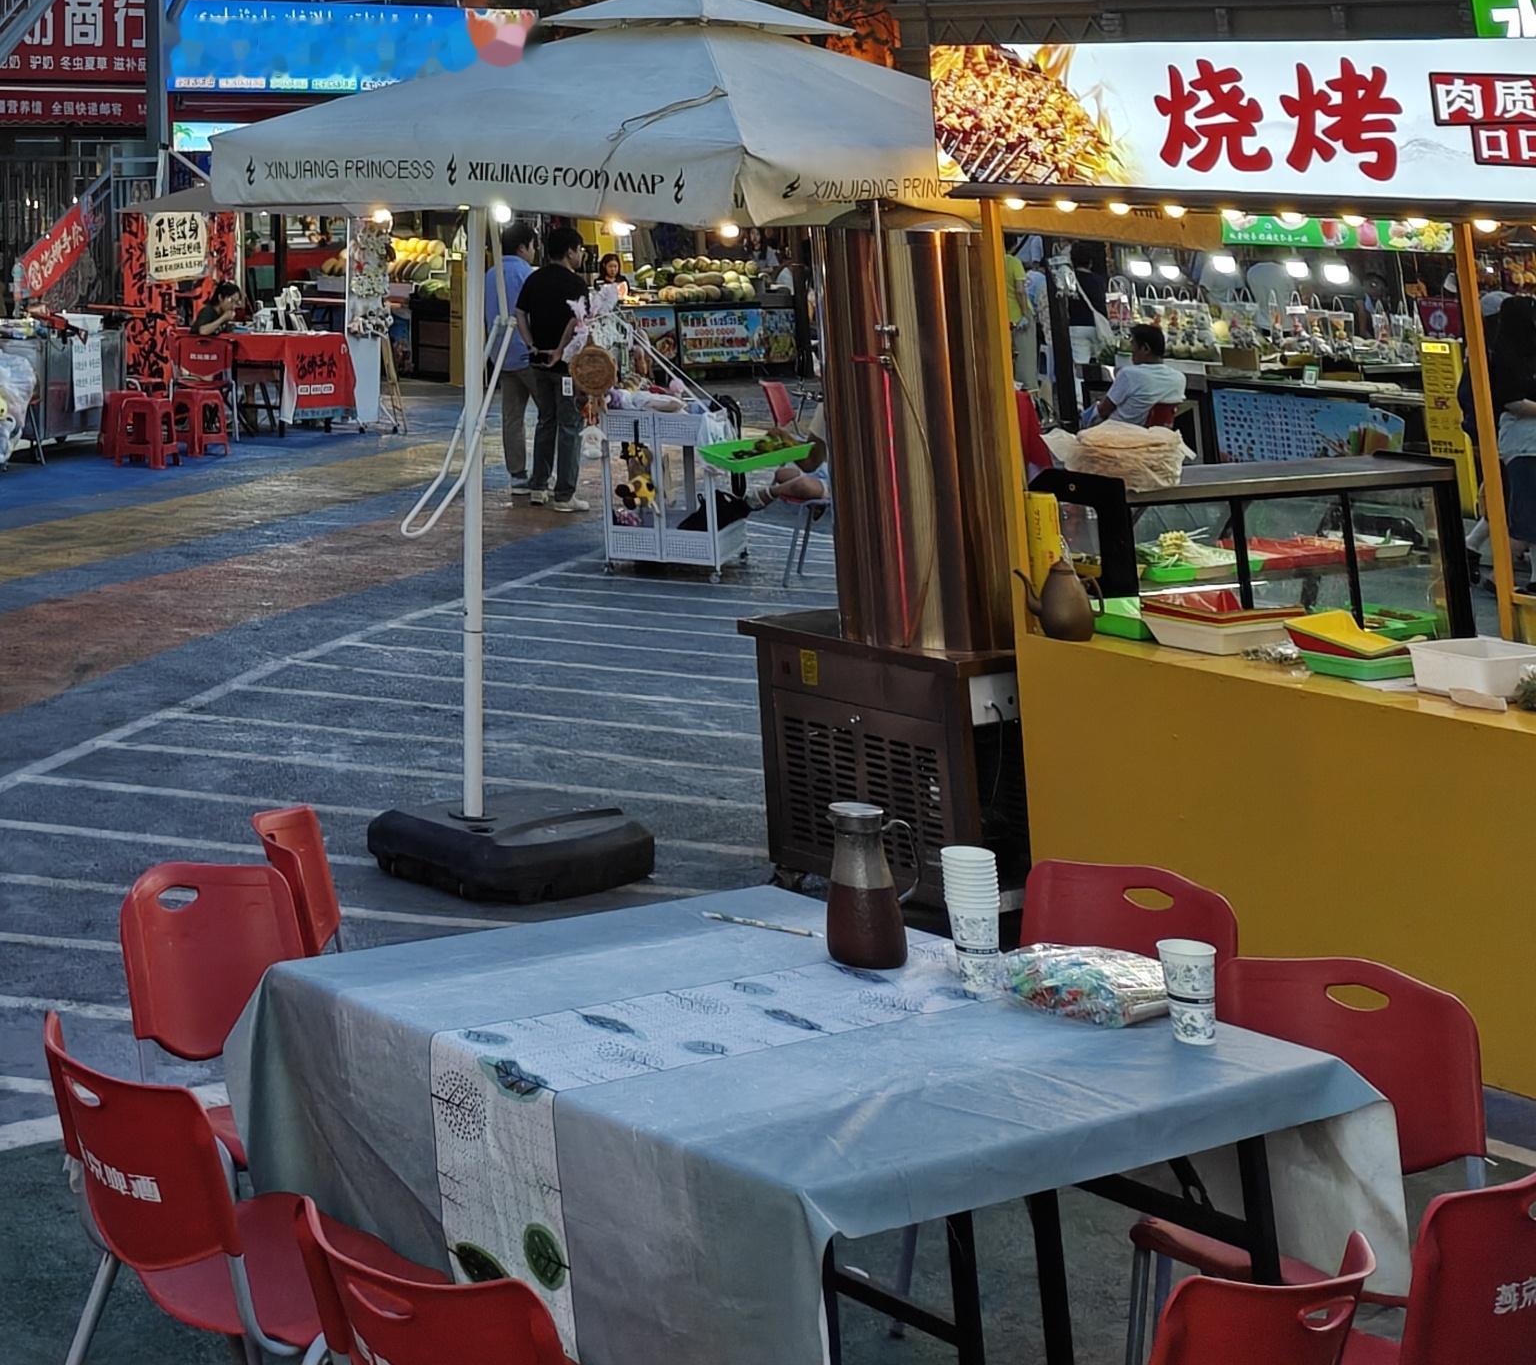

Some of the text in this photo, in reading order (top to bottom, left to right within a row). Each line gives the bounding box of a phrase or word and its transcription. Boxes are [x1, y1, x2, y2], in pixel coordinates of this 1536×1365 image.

[60, 56, 108, 71] 冬虫夏草
[1155, 57, 1402, 181] 烧烤
[264, 159, 435, 181] XINJIANG PRINCESS
[467, 161, 665, 196] XINJIANG FOOD MAP
[809, 178, 899, 199] XINJIANG
[76, 1133, 163, 1203] 京啤酒
